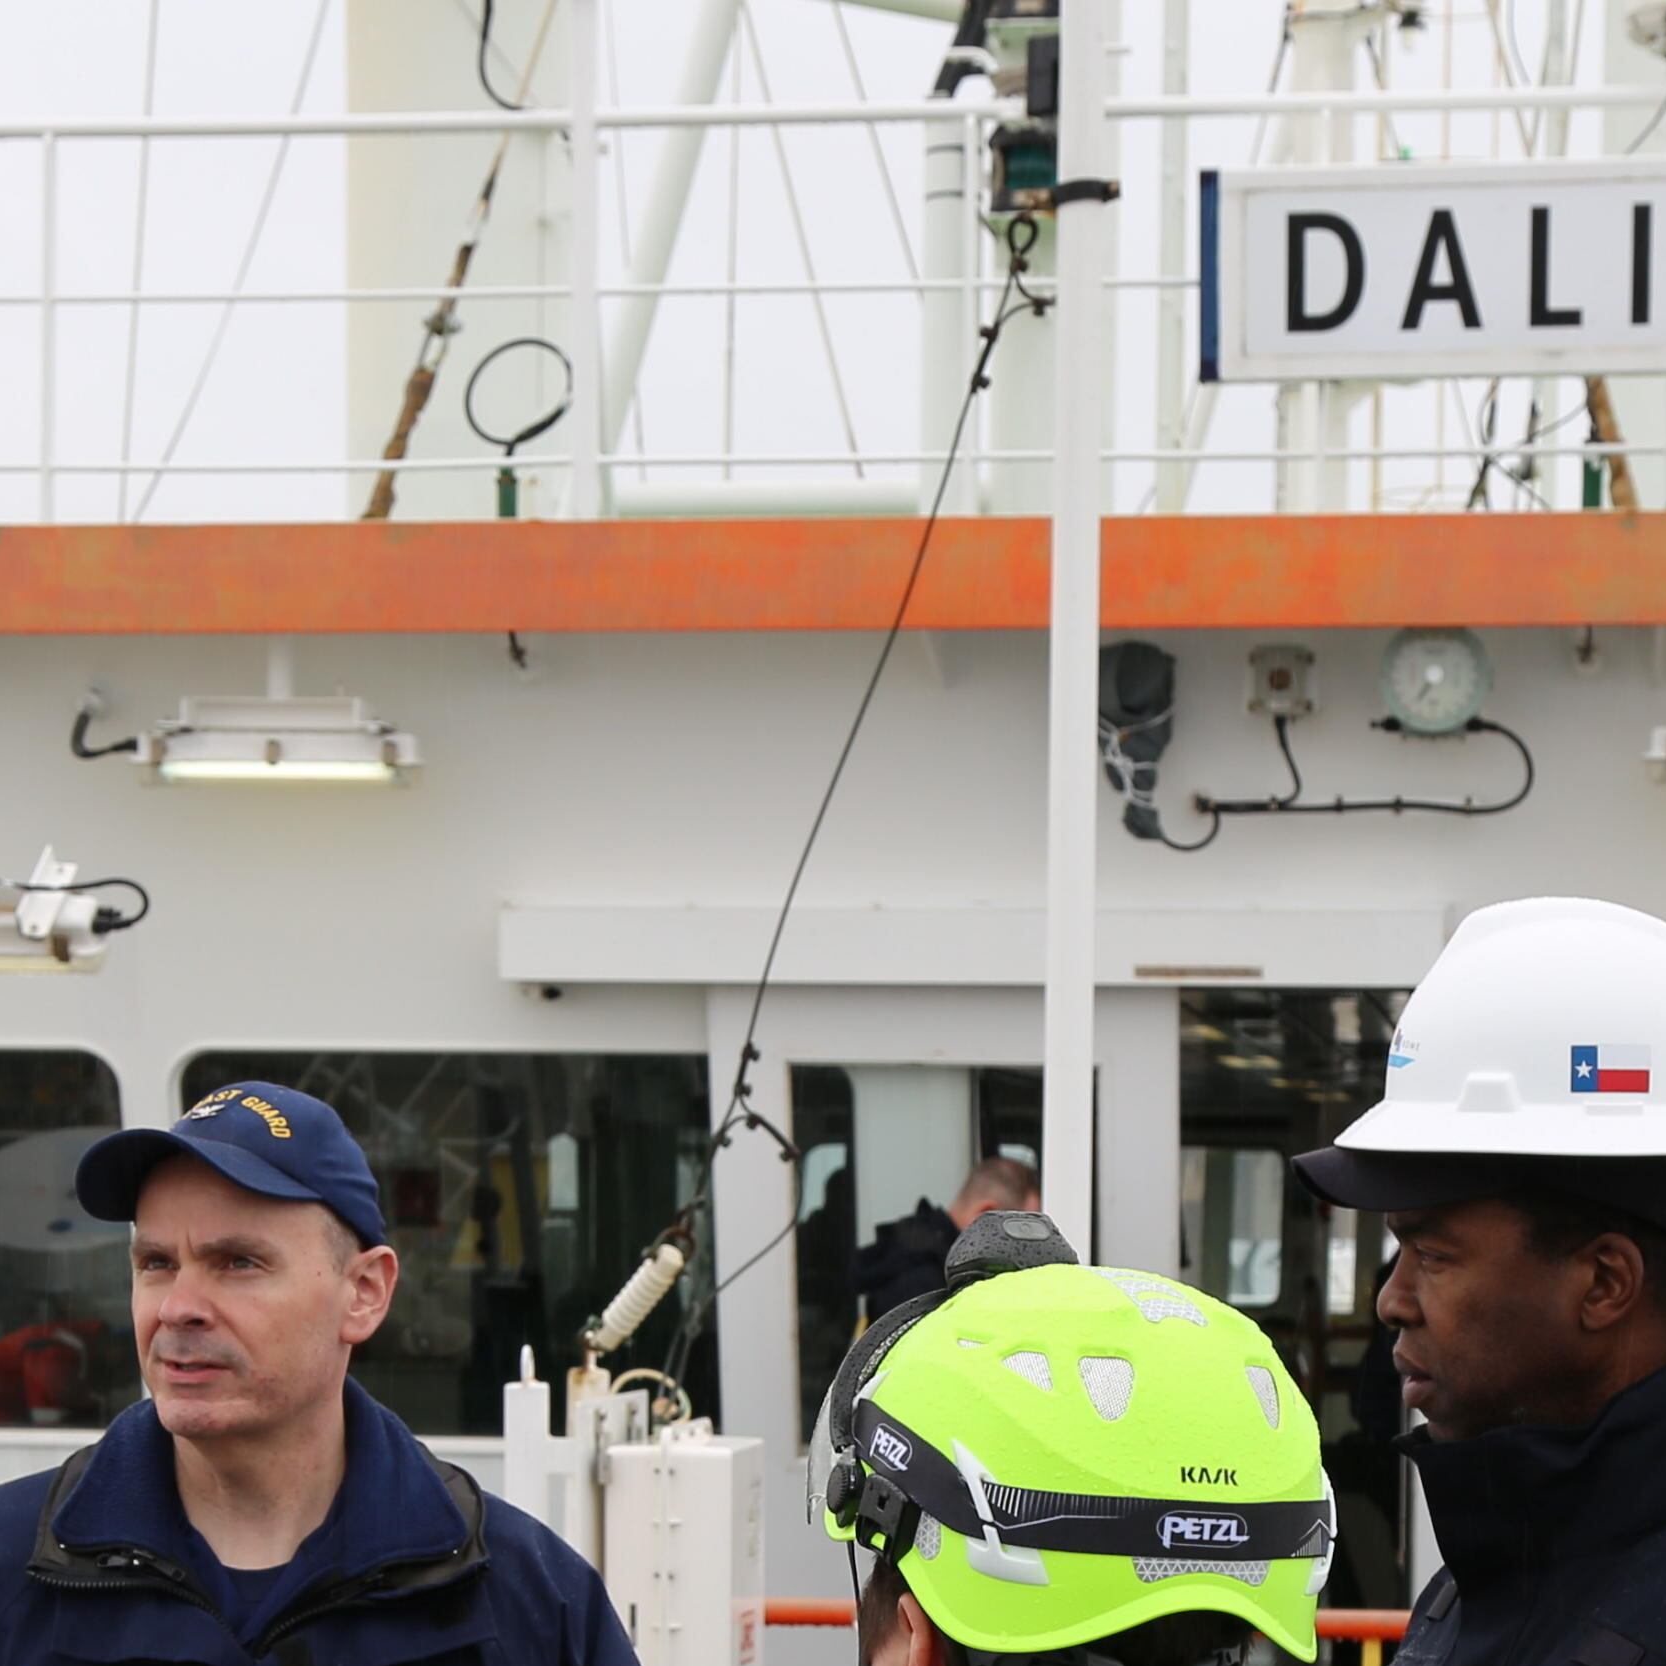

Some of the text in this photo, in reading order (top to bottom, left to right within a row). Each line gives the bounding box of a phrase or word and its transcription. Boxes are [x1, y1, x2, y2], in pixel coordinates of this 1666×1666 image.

[1286, 202, 1653, 333] DALI
[240, 1096, 292, 1137] GUARD
[870, 1427, 908, 1471] PETZL
[1181, 1466, 1239, 1486] KASK
[1162, 1515, 1251, 1549] PETZL
